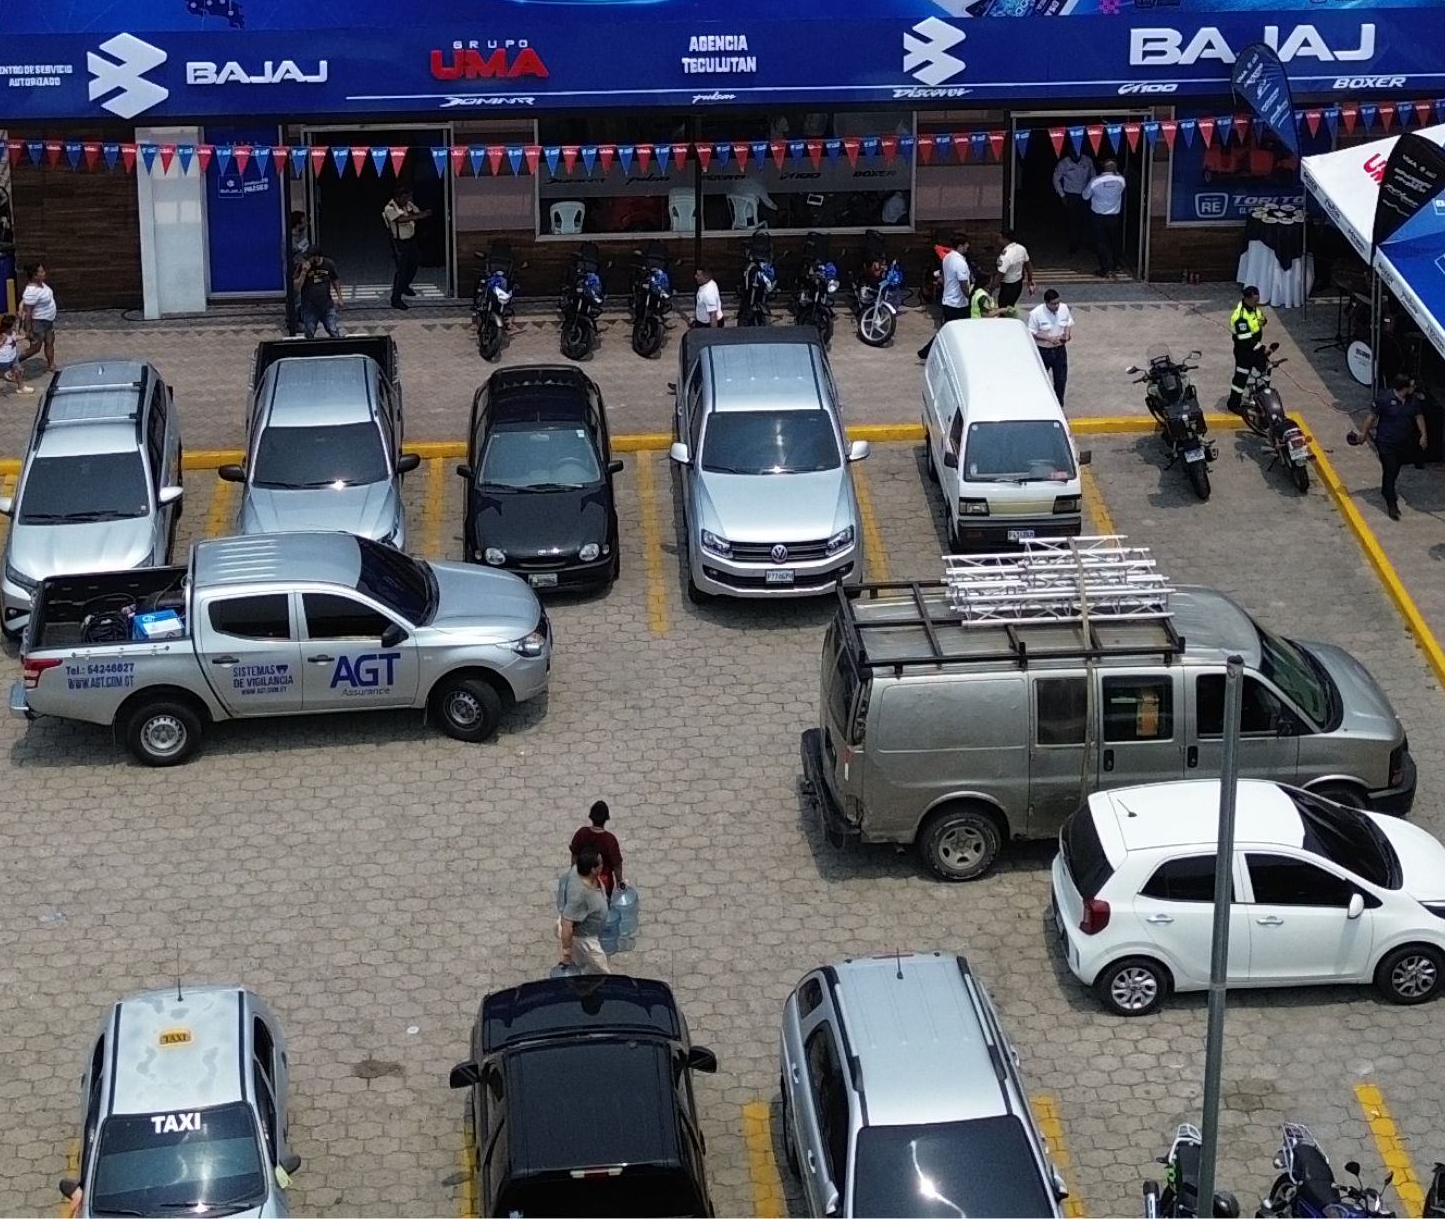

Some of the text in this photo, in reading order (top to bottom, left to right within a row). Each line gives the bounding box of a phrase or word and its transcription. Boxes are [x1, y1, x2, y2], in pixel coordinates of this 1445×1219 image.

[453, 39, 529, 49] GRUPO
[689, 34, 748, 52] AGENCIA
[1130, 23, 1376, 66] BAJAJ
[430, 47, 550, 81] UMA
[682, 56, 757, 75] TECULUTAN
[186, 60, 328, 84] BAJAJ
[1332, 76, 1408, 90] BOXER
[1201, 201, 1221, 213] RE
[66, 665, 86, 675] Tel.:
[233, 665, 276, 677] SISTEMAS
[329, 652, 401, 689] AGT
[233, 675, 294, 688] DE VIGILANCIA
[340, 688, 391, 697] Assurance
[162, 1033, 187, 1044] TAXI
[150, 1112, 202, 1134] TAXI
